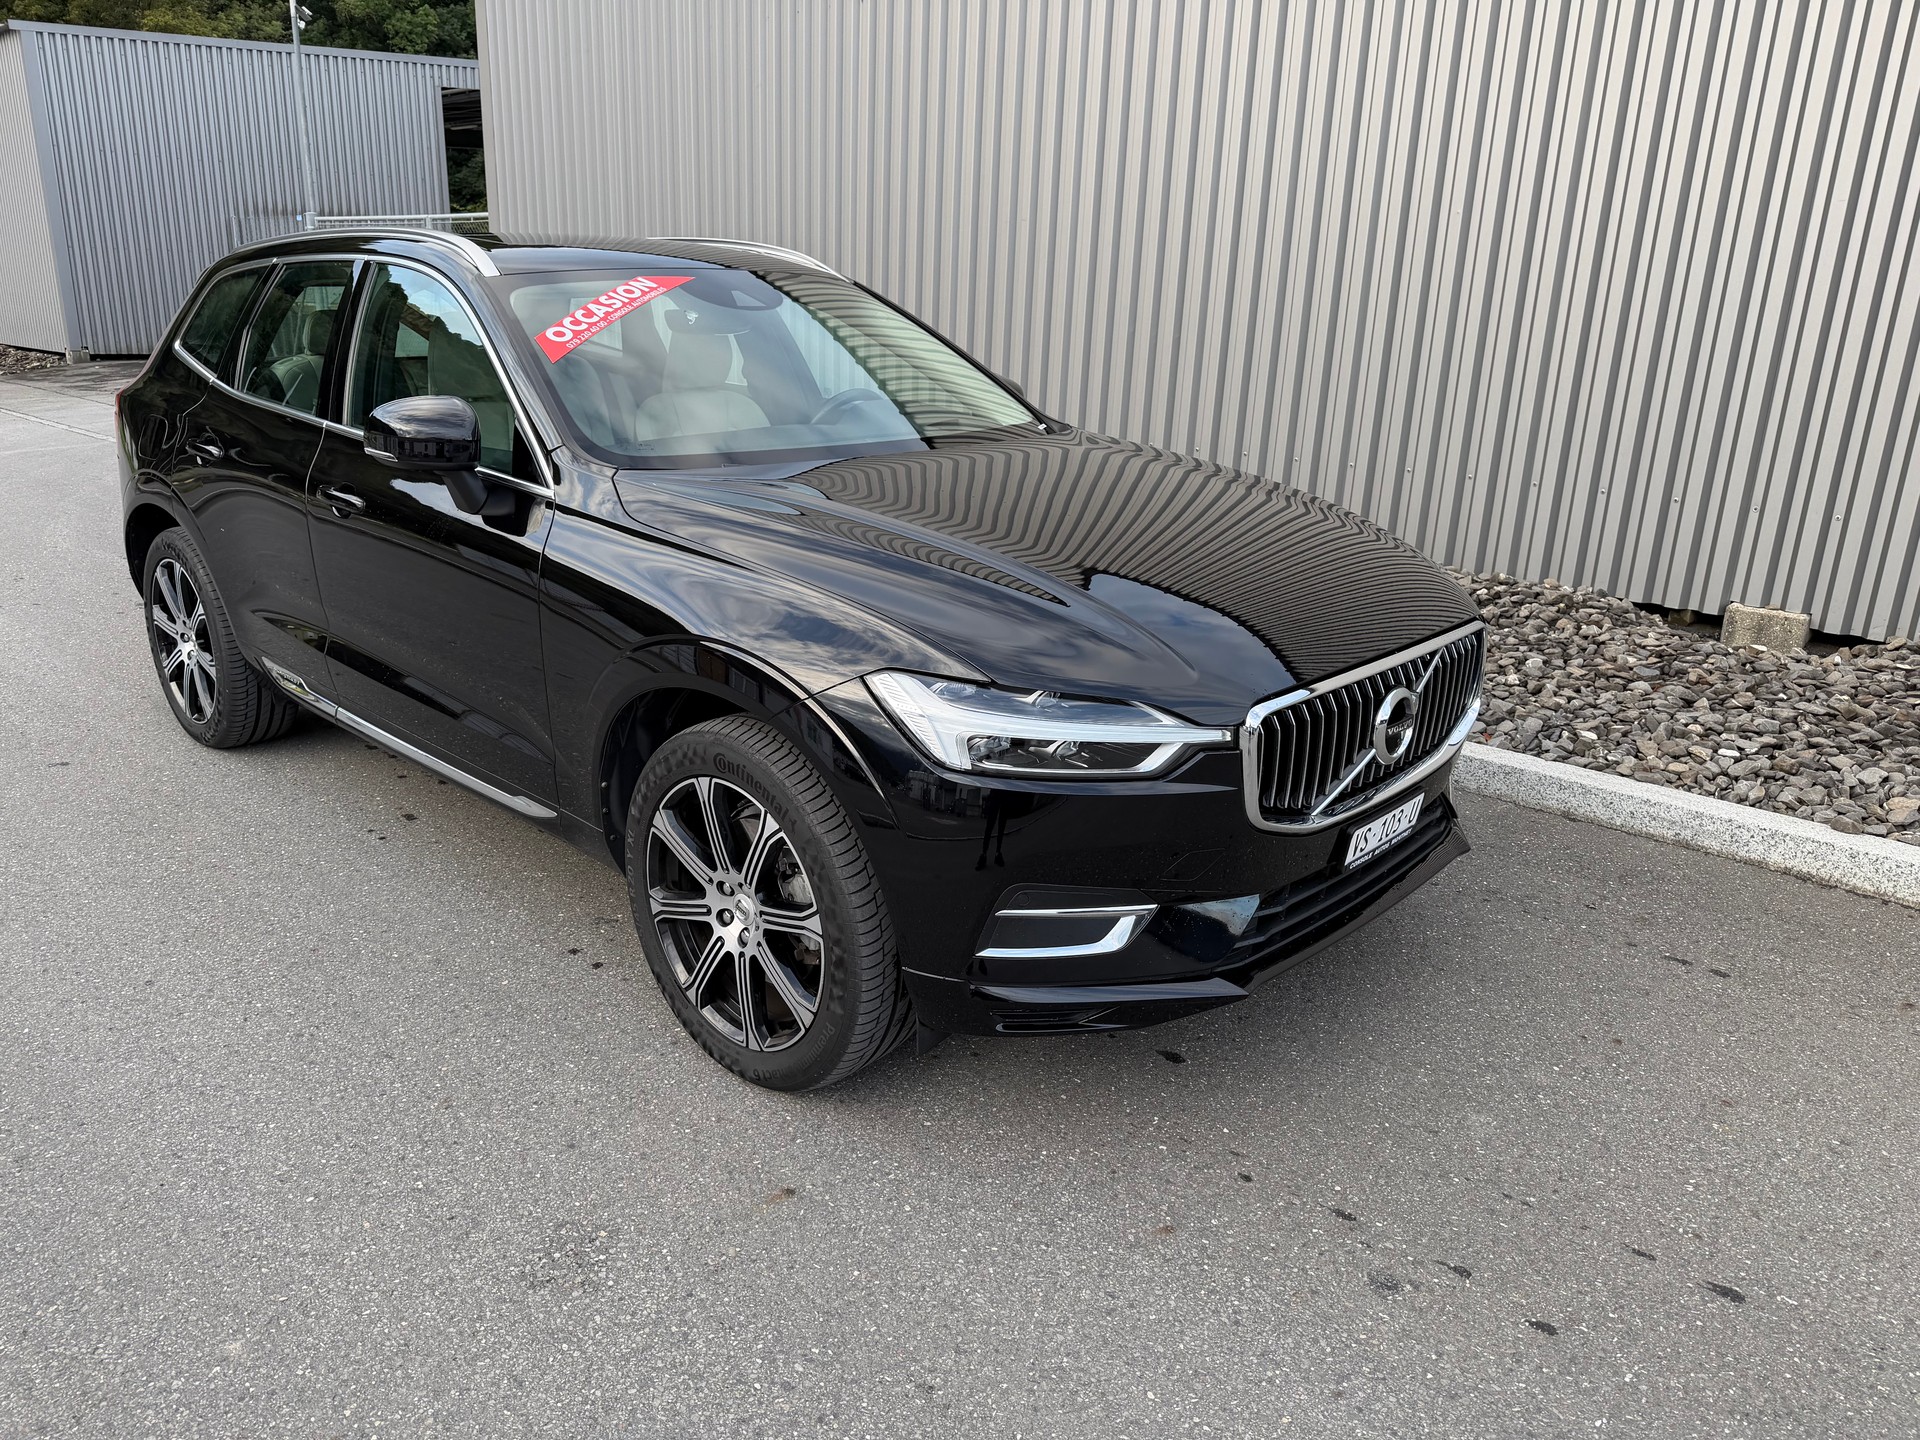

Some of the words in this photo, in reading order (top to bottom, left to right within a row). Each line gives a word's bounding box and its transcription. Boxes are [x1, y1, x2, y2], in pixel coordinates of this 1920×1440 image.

[545, 276, 658, 342] OCCASION
[566, 338, 580, 348] 079
[577, 330, 592, 340] 220
[589, 325, 600, 333] 40
[596, 320, 608, 328] 00
[1387, 718, 1413, 735] VOLVO
[713, 752, 789, 822] Continental
[627, 828, 635, 847] XL
